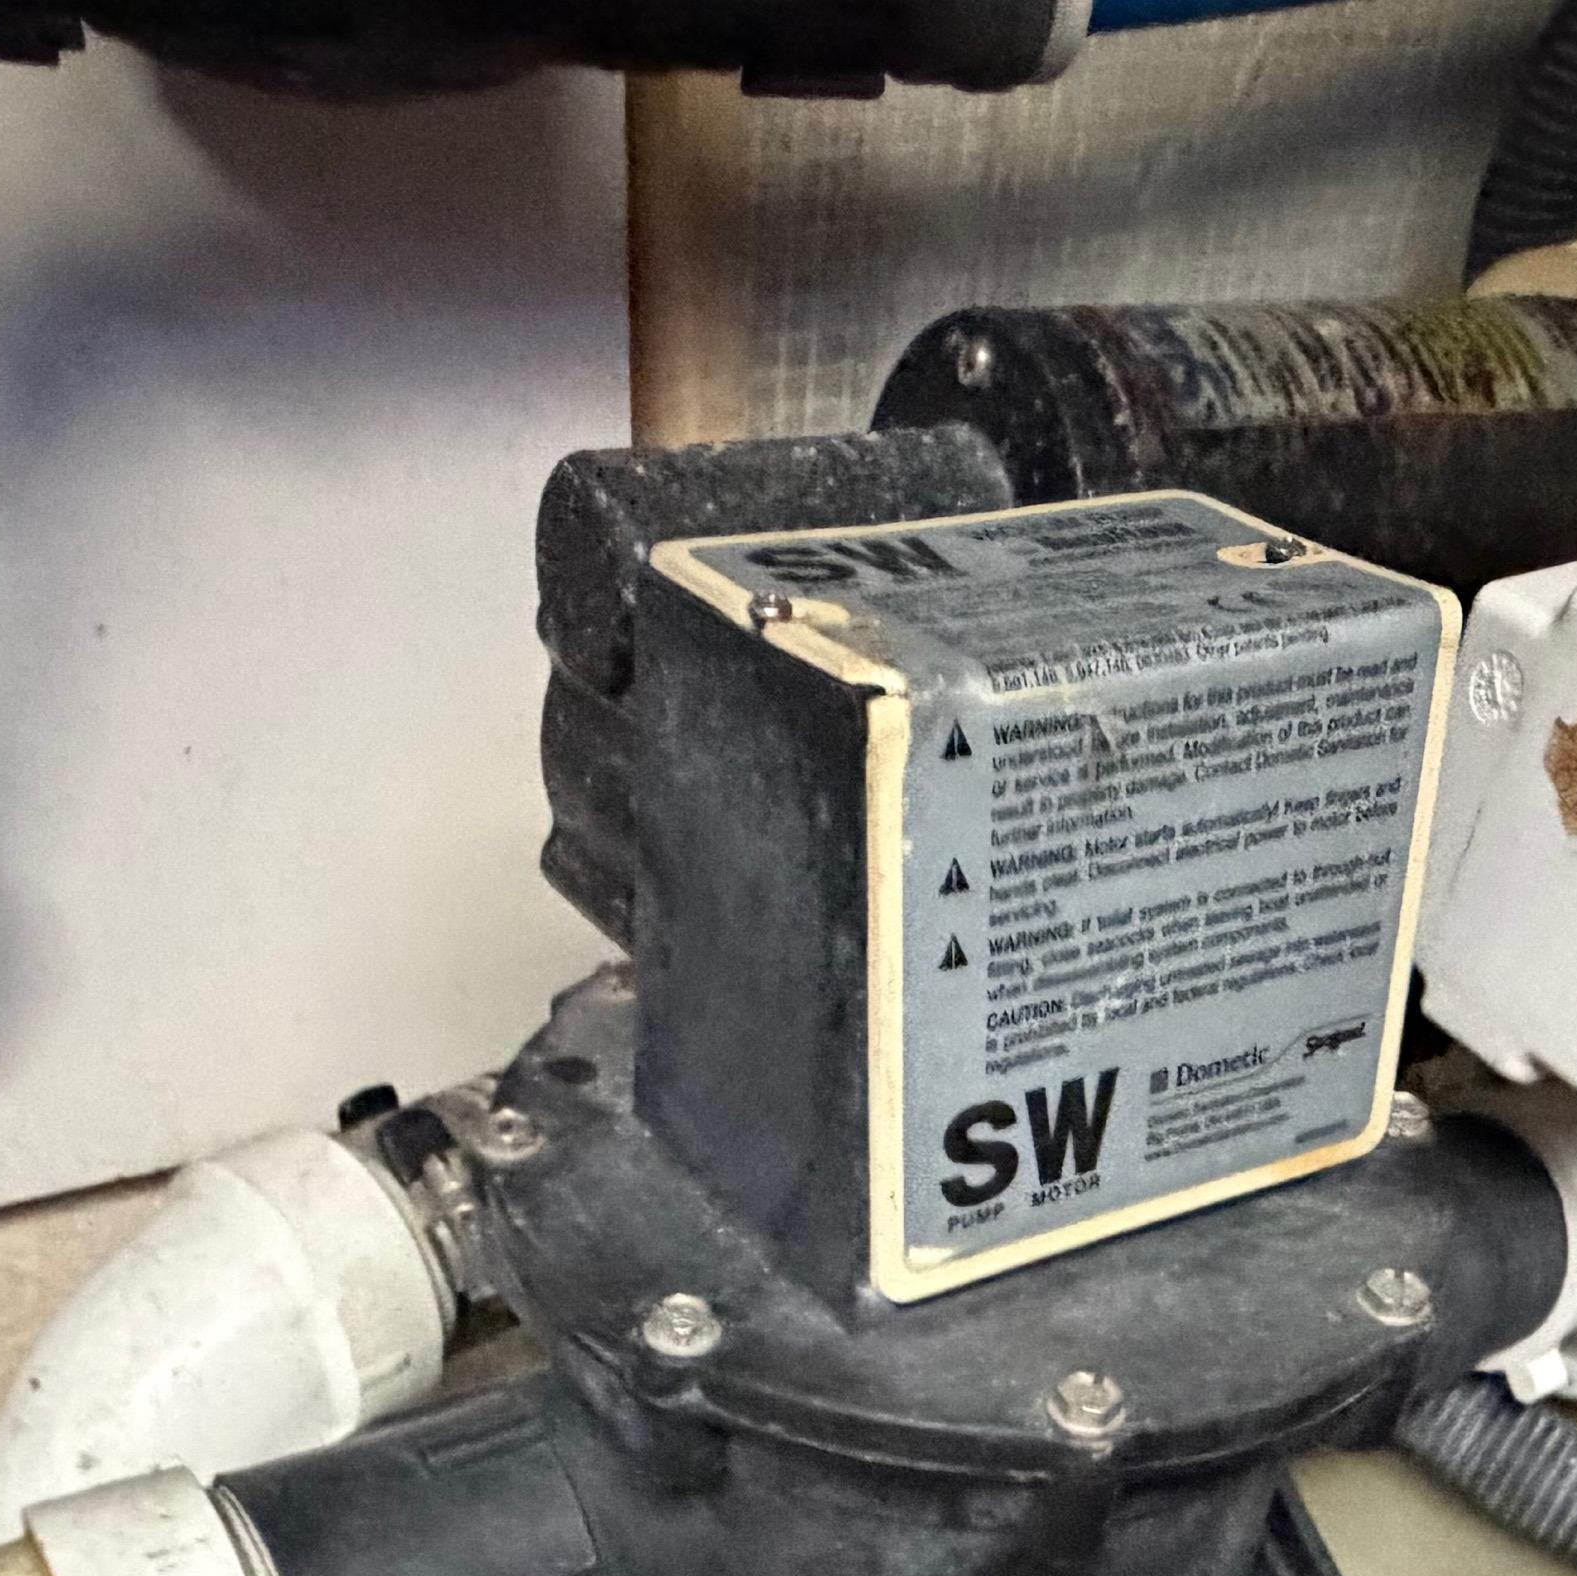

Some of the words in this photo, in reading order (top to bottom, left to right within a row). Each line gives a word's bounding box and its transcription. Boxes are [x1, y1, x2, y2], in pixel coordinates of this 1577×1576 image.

[746, 536, 960, 584] SW
[1277, 719, 1293, 742] of
[1176, 1044, 1271, 1087] Dometic
[940, 1068, 1119, 1207] SW
[948, 1203, 1005, 1232] PUMP
[1030, 1173, 1102, 1207] MOTOR
